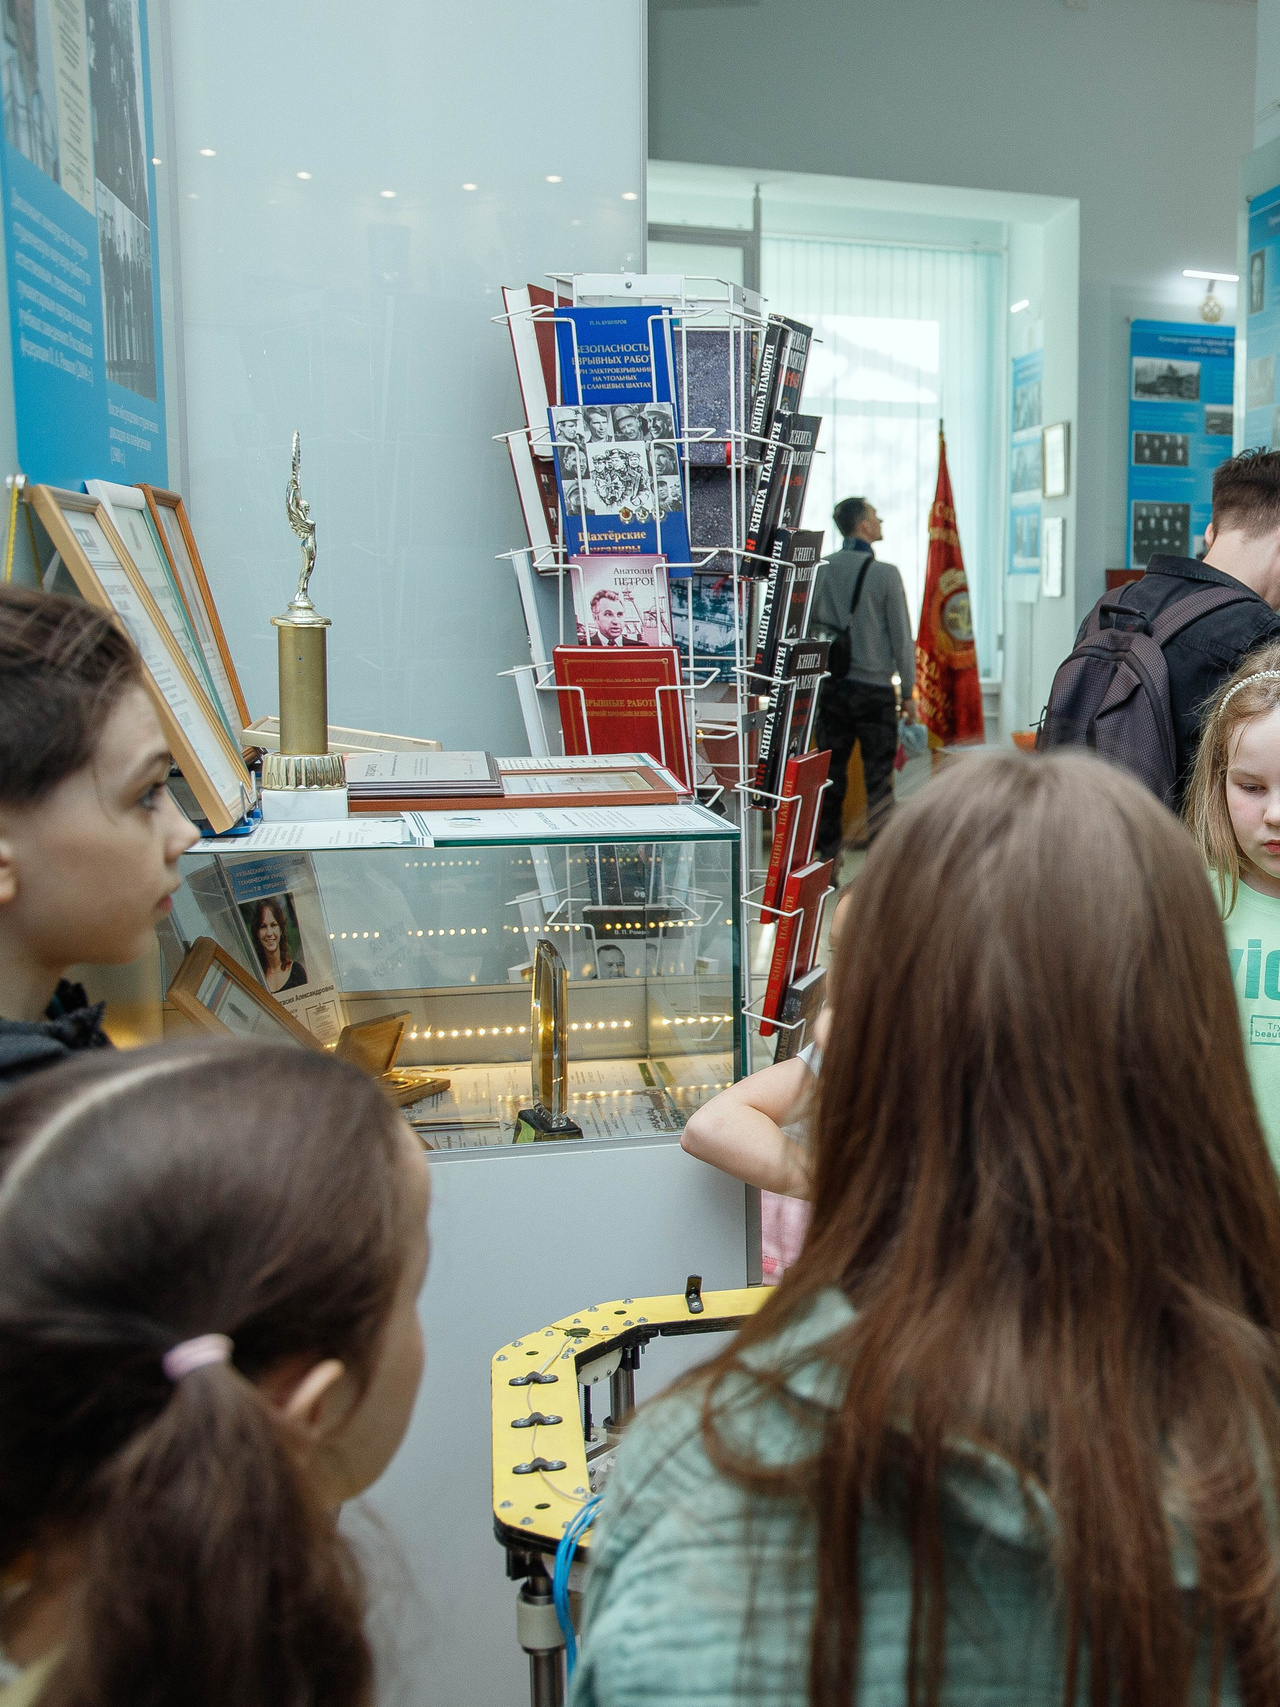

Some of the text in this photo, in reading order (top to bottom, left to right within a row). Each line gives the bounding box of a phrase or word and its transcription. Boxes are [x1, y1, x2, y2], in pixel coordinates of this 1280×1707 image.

[624, 354, 651, 364] РАБО
[751, 344, 775, 434] КНИГА ПАМЯТИ
[781, 450, 812, 466] ПМЯТИ
[749, 488, 768, 534] КНИГА
[580, 544, 641, 553] бигадиры
[786, 567, 816, 582] ПМЯТ
[757, 603, 773, 650] КНИГА
[759, 711, 776, 761] КНИГА
[779, 780, 793, 826] ПАМТИ
[780, 895, 794, 940] ПАМТИ
